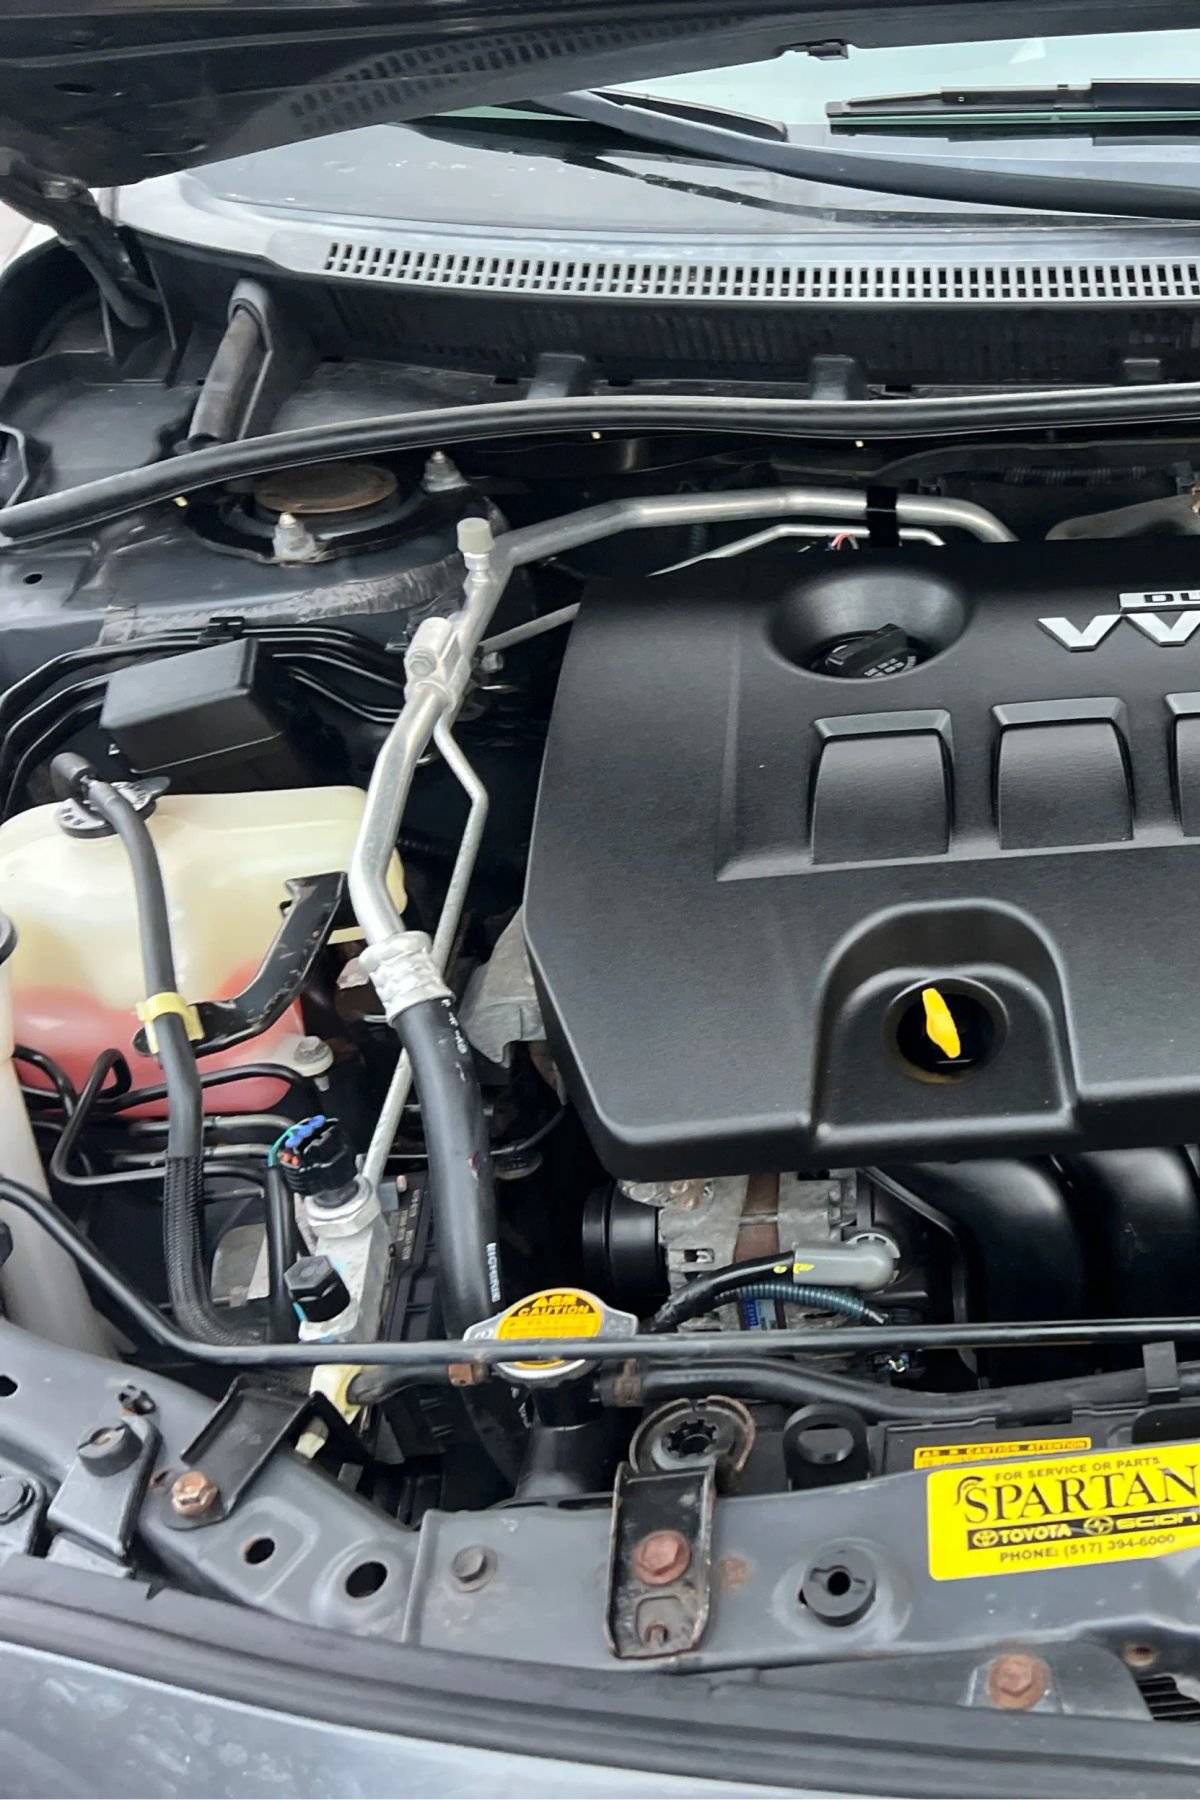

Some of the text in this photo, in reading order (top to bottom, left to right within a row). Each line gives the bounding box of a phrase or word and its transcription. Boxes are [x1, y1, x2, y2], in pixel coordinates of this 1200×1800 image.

[517, 1304, 590, 1317] CAUTION
[995, 1456, 1160, 1482] FOR SERVICE OR PARTS
[955, 1463, 1199, 1524] SPARTAN
[1000, 1523, 1072, 1544] TOYOTA
[1064, 1543, 1103, 1557] (517)
[1108, 1533, 1175, 1551] 394-6000
